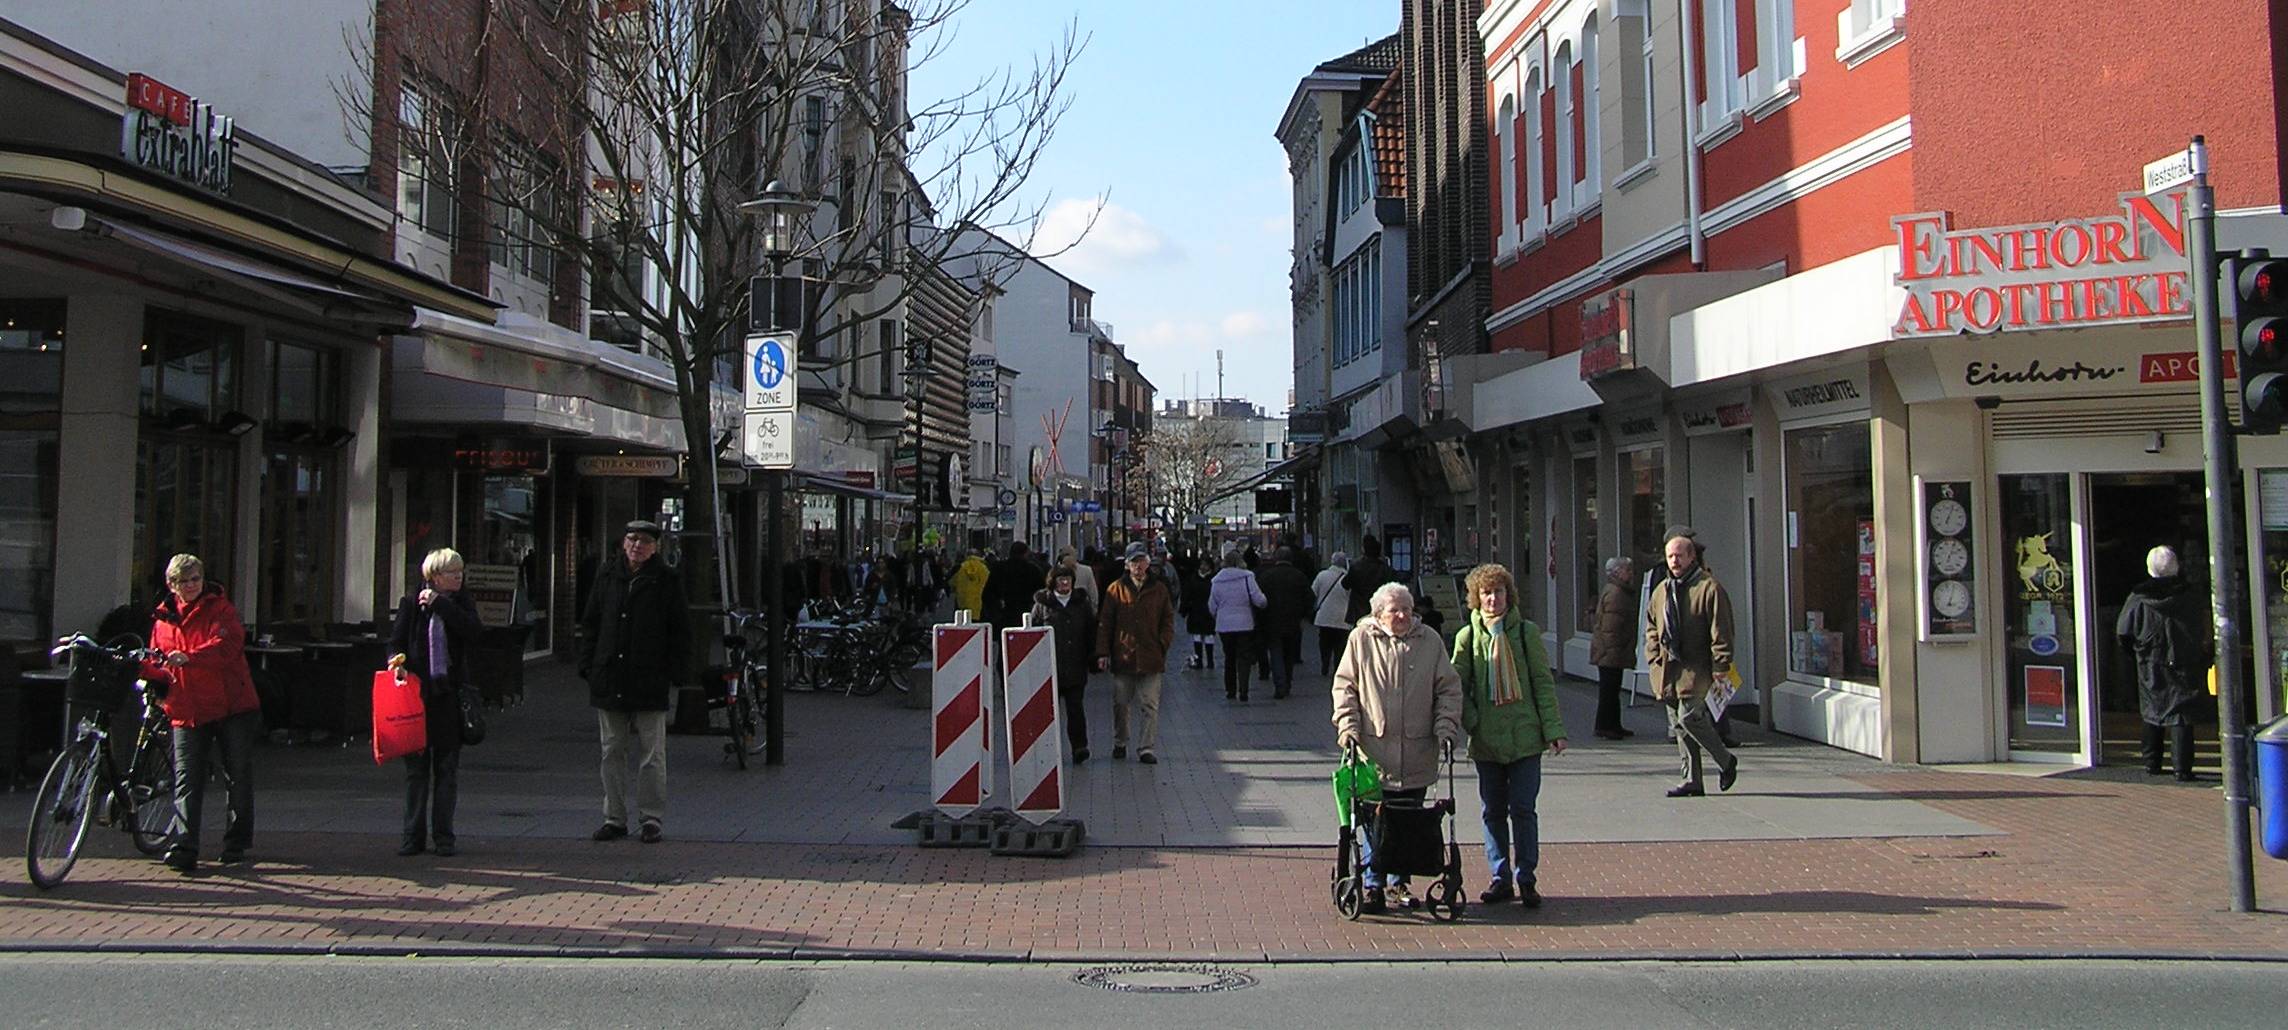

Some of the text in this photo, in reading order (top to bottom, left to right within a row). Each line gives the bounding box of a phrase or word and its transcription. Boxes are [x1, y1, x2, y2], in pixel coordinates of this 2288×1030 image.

[136, 97, 239, 196] extrablatt
[2147, 157, 2188, 188] Weststraß
[1896, 271, 2188, 334] APOTHEKE
[969, 356, 996, 367] GÖRTZ
[969, 377, 996, 388] GÖRTZ
[757, 392, 782, 405] ZONE
[969, 399, 996, 410] GÖRTZ
[762, 440, 775, 450] frei
